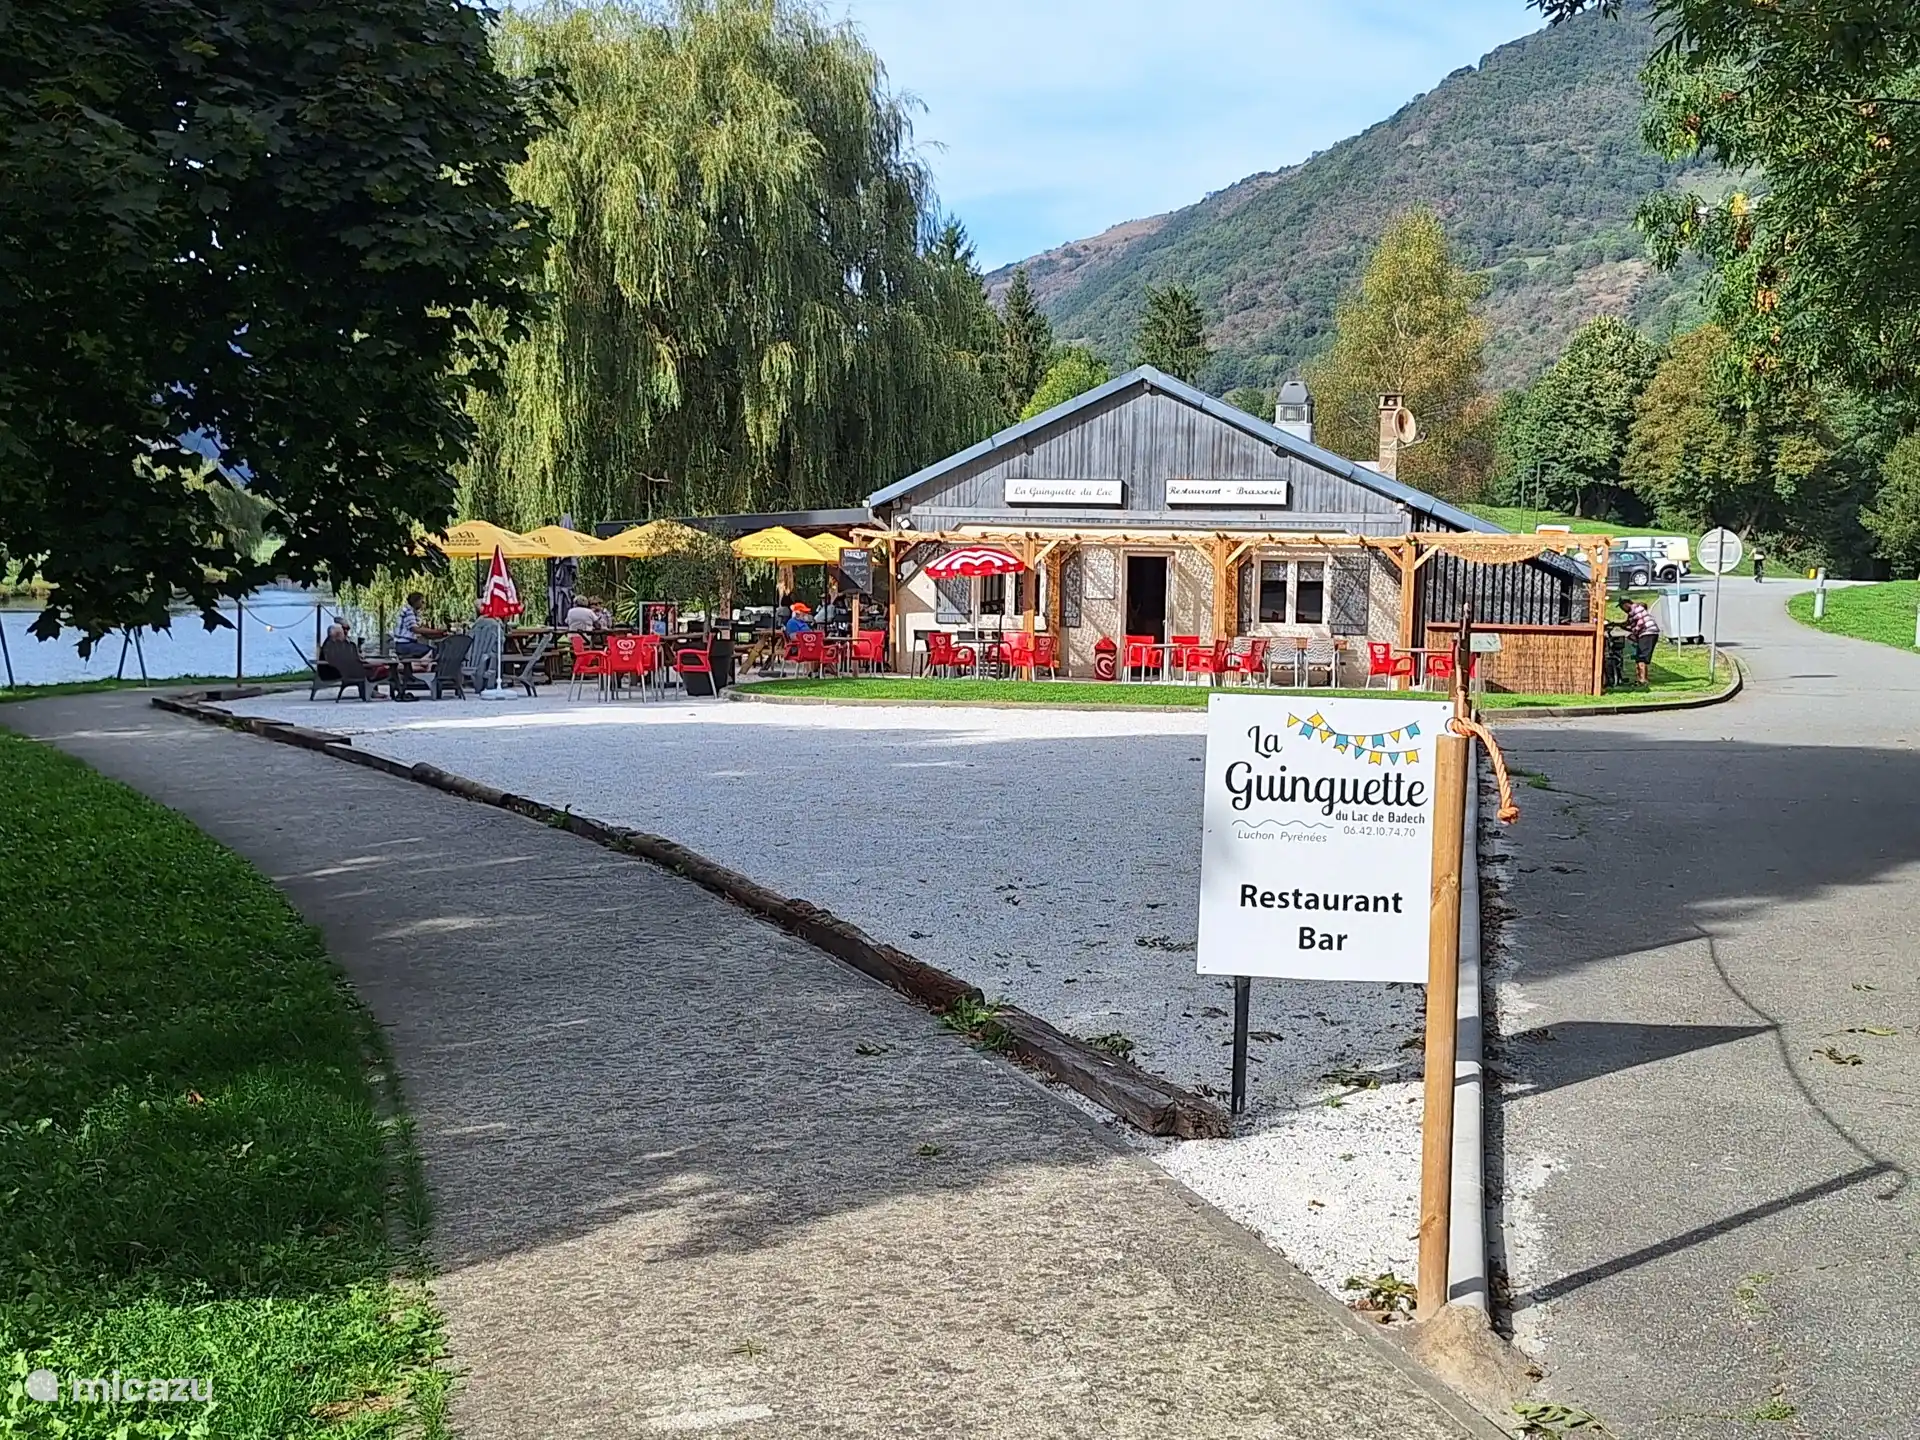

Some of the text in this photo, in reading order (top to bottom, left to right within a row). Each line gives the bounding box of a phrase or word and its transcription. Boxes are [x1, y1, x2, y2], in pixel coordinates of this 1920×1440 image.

[1013, 486, 1113, 497] La Guinguette du Lac
[1168, 486, 1222, 495] Restaurant
[1236, 486, 1282, 495] Brasserie
[1247, 725, 1283, 758] La
[1225, 761, 1428, 816] Guinguette
[1335, 810, 1426, 824] du Lac de Badech
[1237, 829, 1328, 843] Luchon Pyrénées
[1343, 825, 1416, 837] 06.42.10.74.70
[1240, 884, 1403, 914] Restaurant
[1298, 926, 1349, 951] Bar
